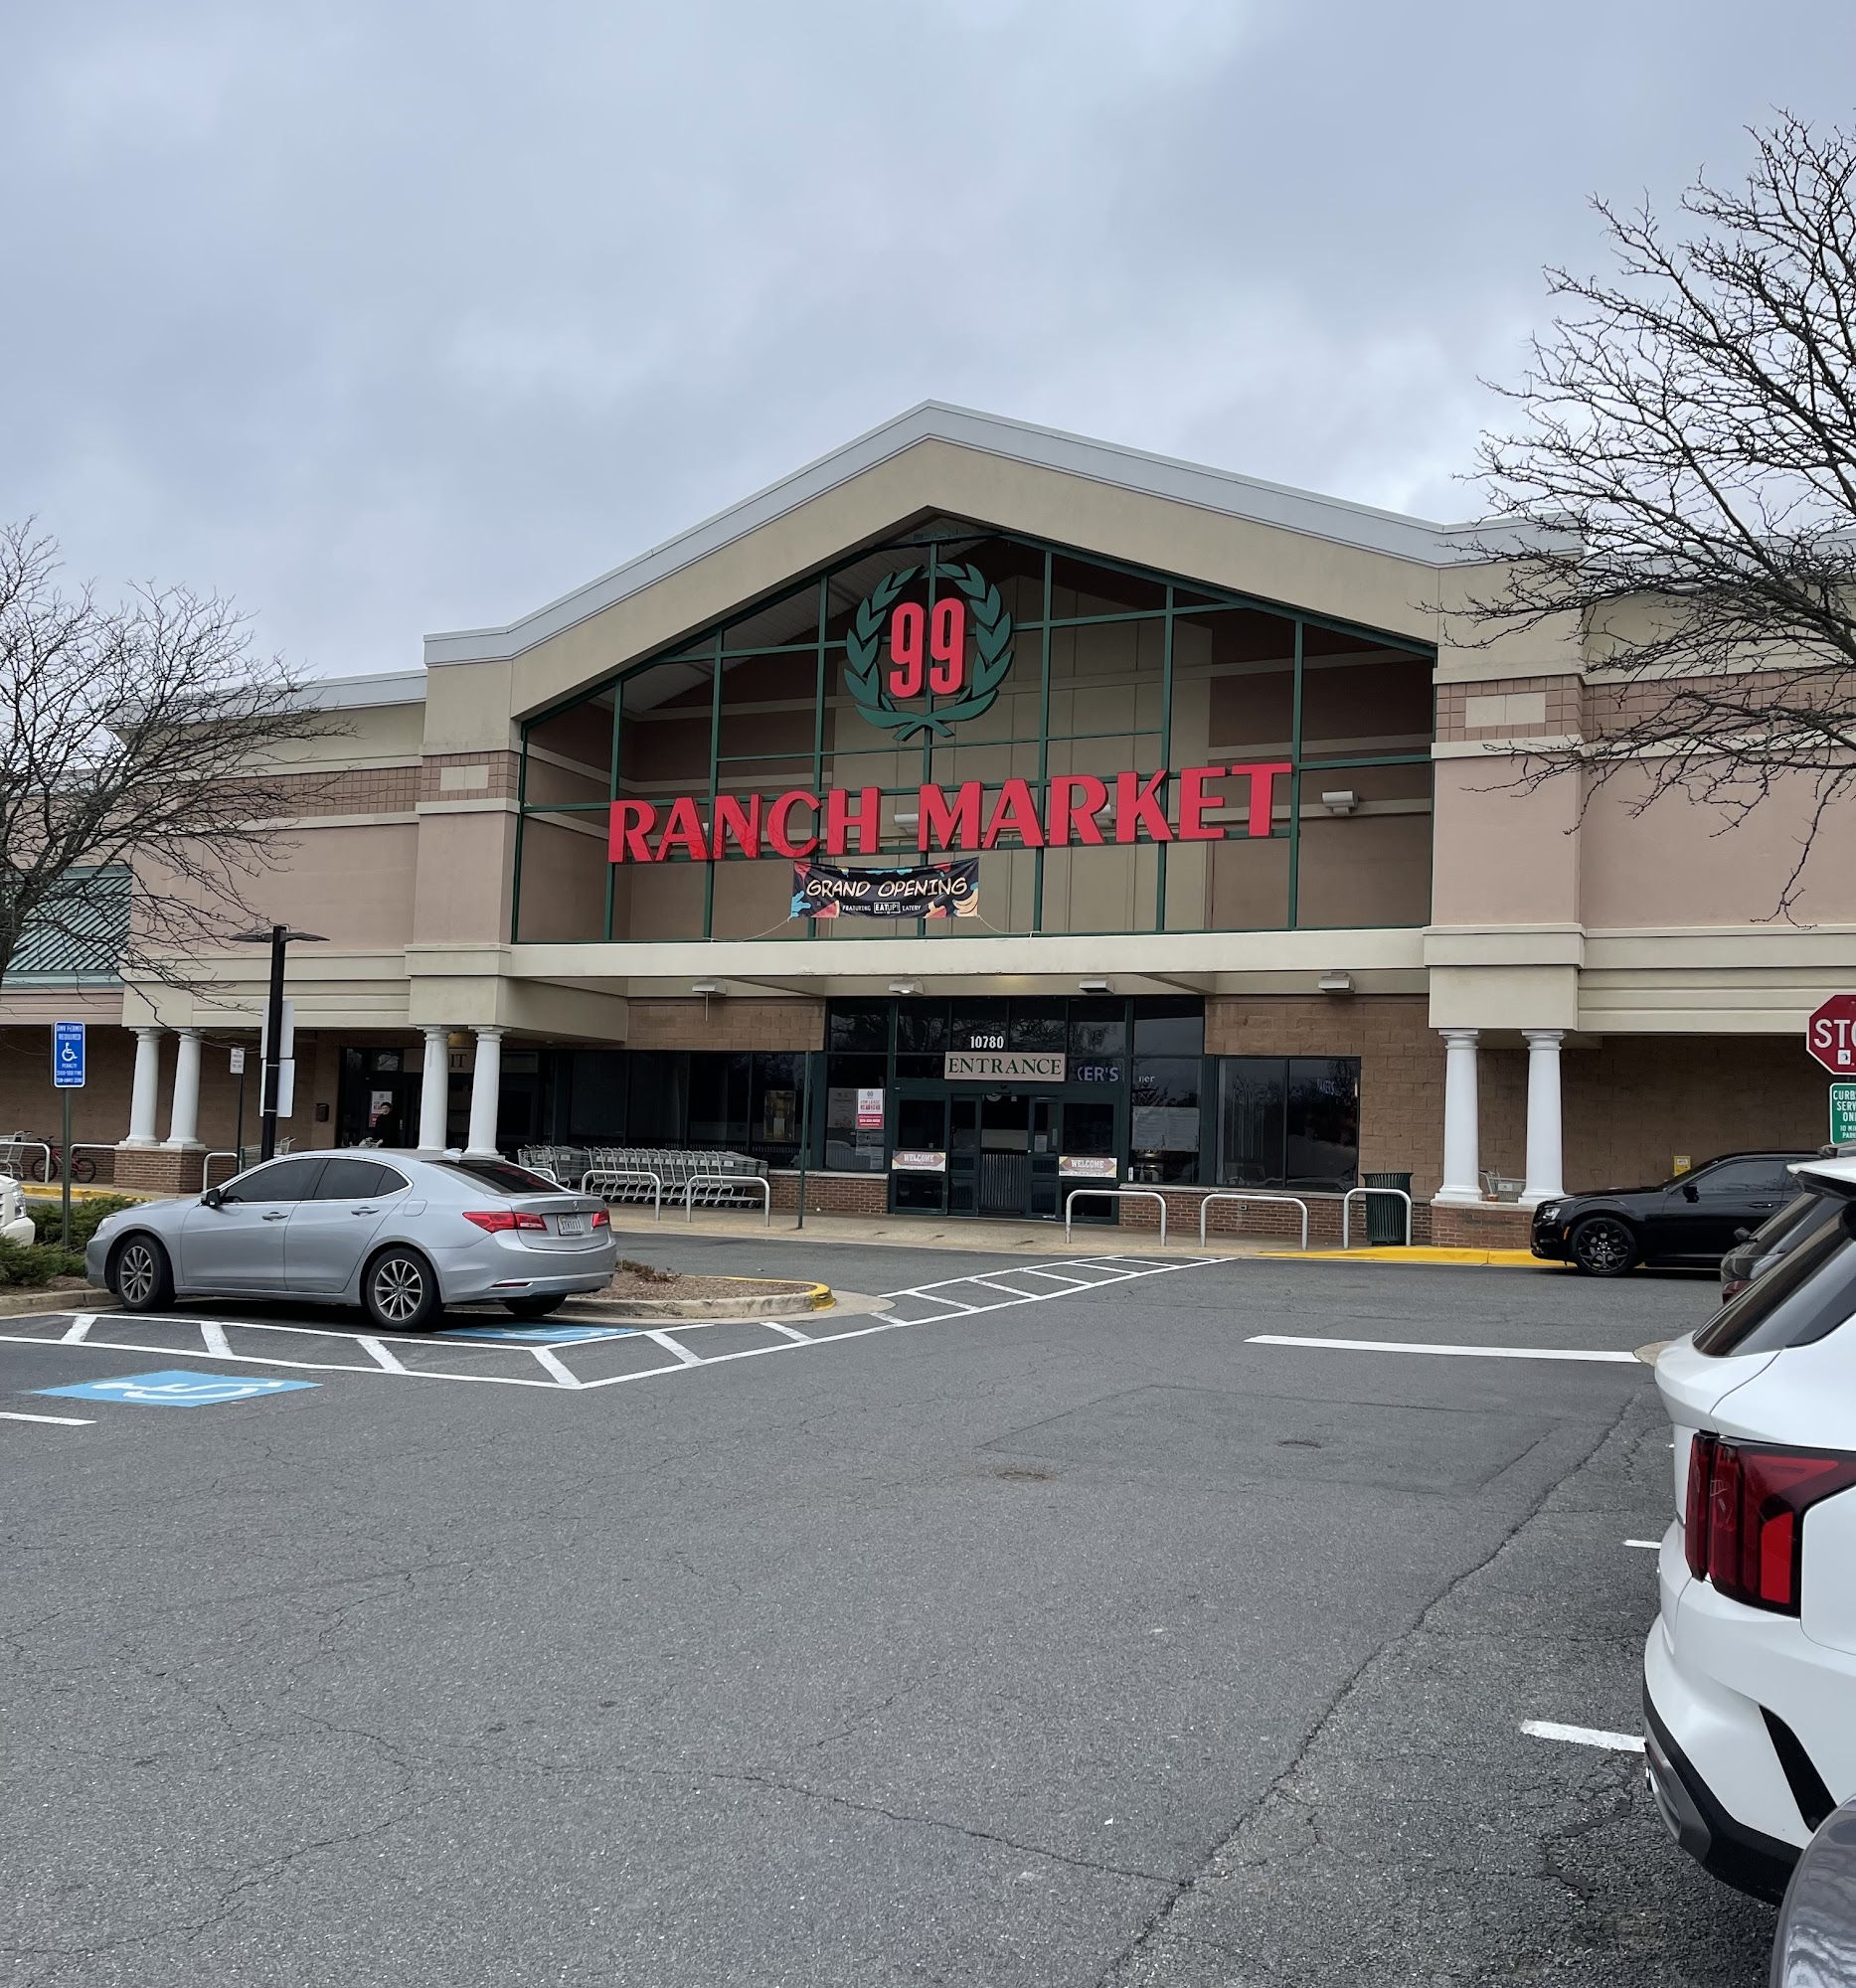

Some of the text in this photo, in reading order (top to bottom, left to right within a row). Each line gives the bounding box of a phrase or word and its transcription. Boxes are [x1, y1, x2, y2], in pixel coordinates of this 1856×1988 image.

[889, 596, 967, 698] 99
[607, 762, 1293, 864] RANCH MARKET
[806, 877, 968, 898] GRAND OPENING
[970, 1036, 1004, 1049] 10780
[450, 1054, 466, 1069] IT
[947, 1058, 1062, 1076] ENTRANCE
[1833, 1089, 1856, 1100] CURB
